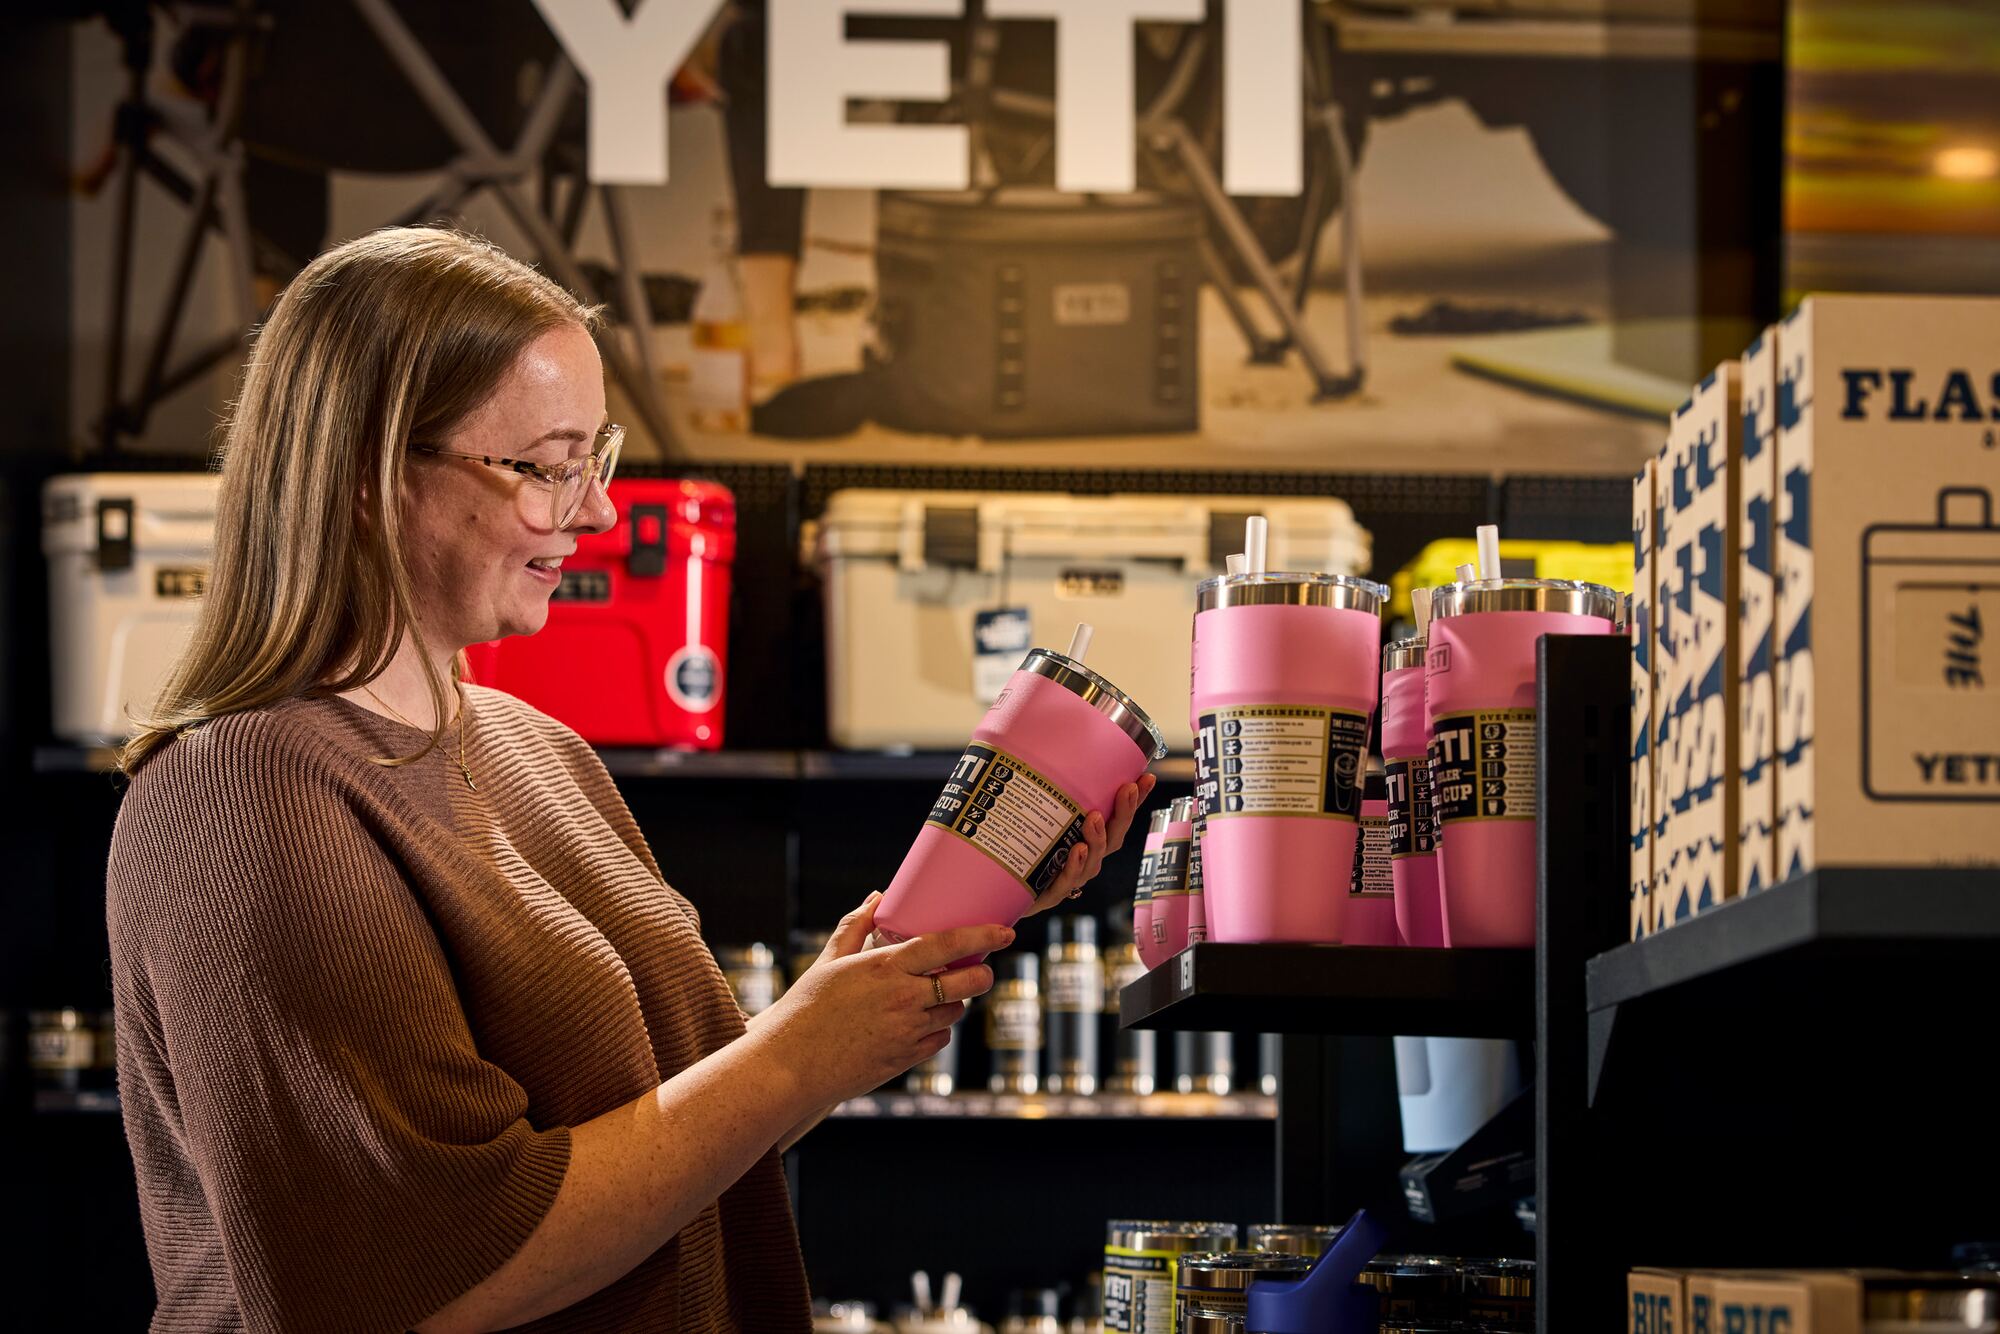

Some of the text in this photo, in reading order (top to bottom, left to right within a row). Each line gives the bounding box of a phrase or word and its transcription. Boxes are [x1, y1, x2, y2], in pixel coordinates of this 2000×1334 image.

[529, 0, 1304, 195] YETI
[1840, 368, 2000, 422] FLA
[1740, 330, 1773, 900] FLASK
[1776, 300, 1813, 884] FLASK
[1944, 603, 1985, 690] THE
[1220, 708, 1326, 719] OVER-ENGINEERED
[999, 755, 1078, 814] OVER-ENGINEERED
[1443, 784, 1473, 803] CUP
[1633, 1292, 1673, 1334] BIG
